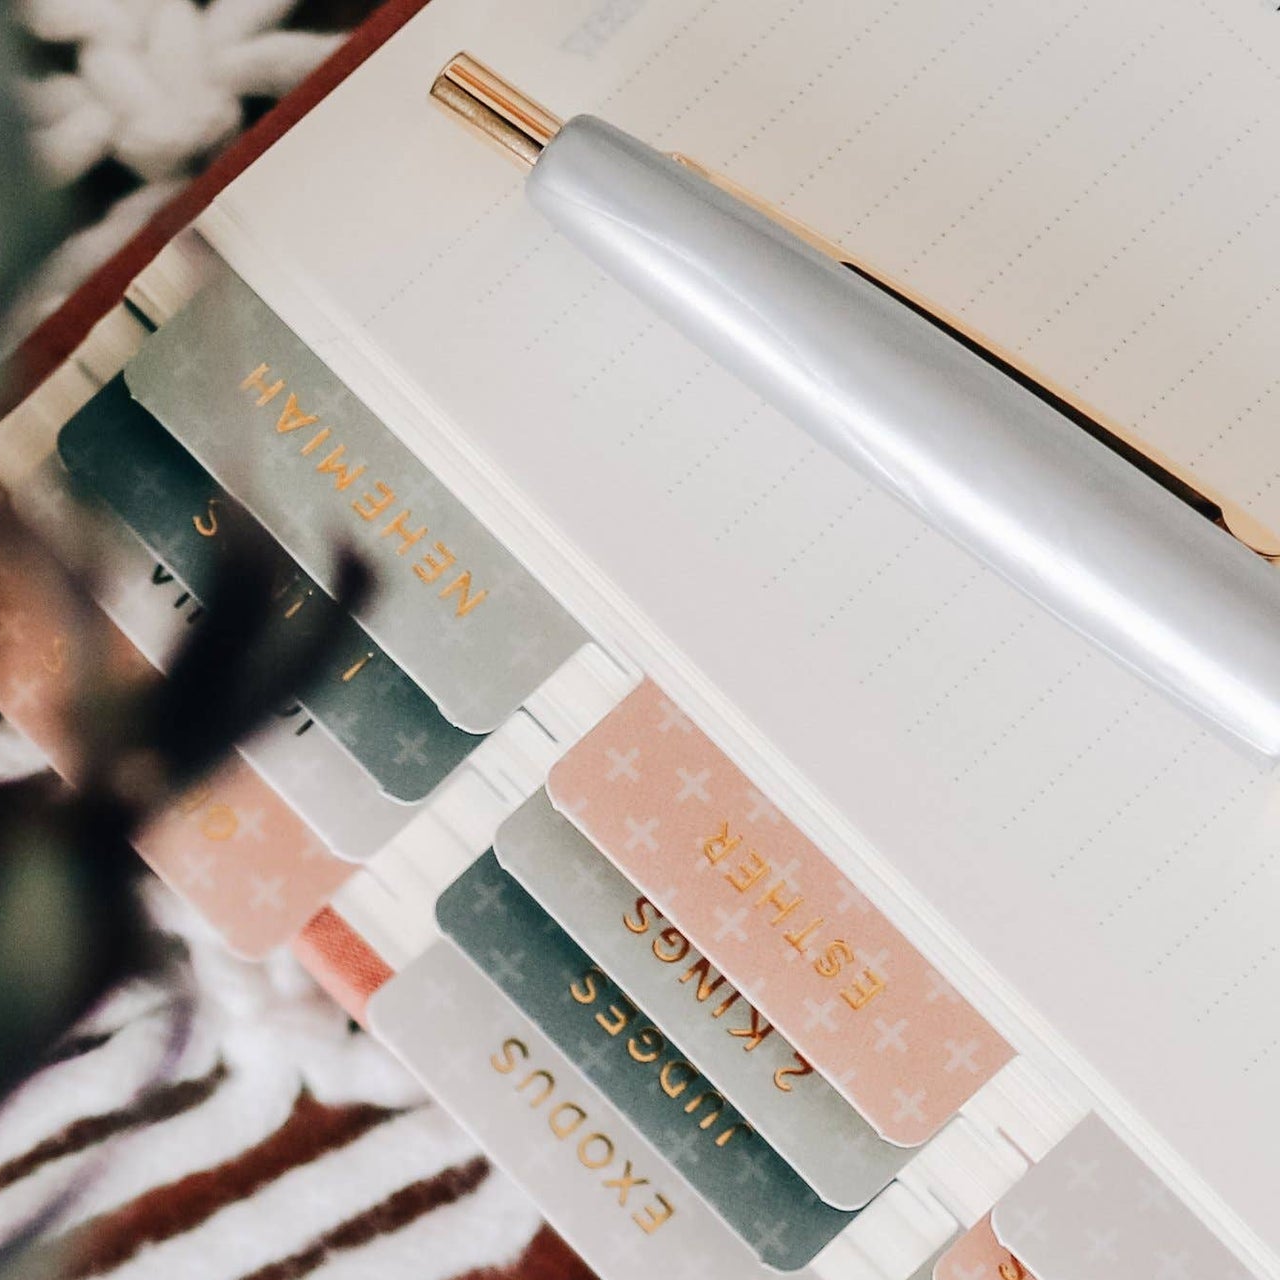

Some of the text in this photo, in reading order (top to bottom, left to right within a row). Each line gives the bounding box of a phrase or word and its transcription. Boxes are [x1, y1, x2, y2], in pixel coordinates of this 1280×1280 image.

[237, 360, 487, 616] NEHEMIAH
[621, 896, 813, 1093] 2 KINGS
[697, 821, 885, 1011] ESTHER
[490, 1037, 675, 1234] EXODUS
[569, 963, 752, 1147] JUDGES
